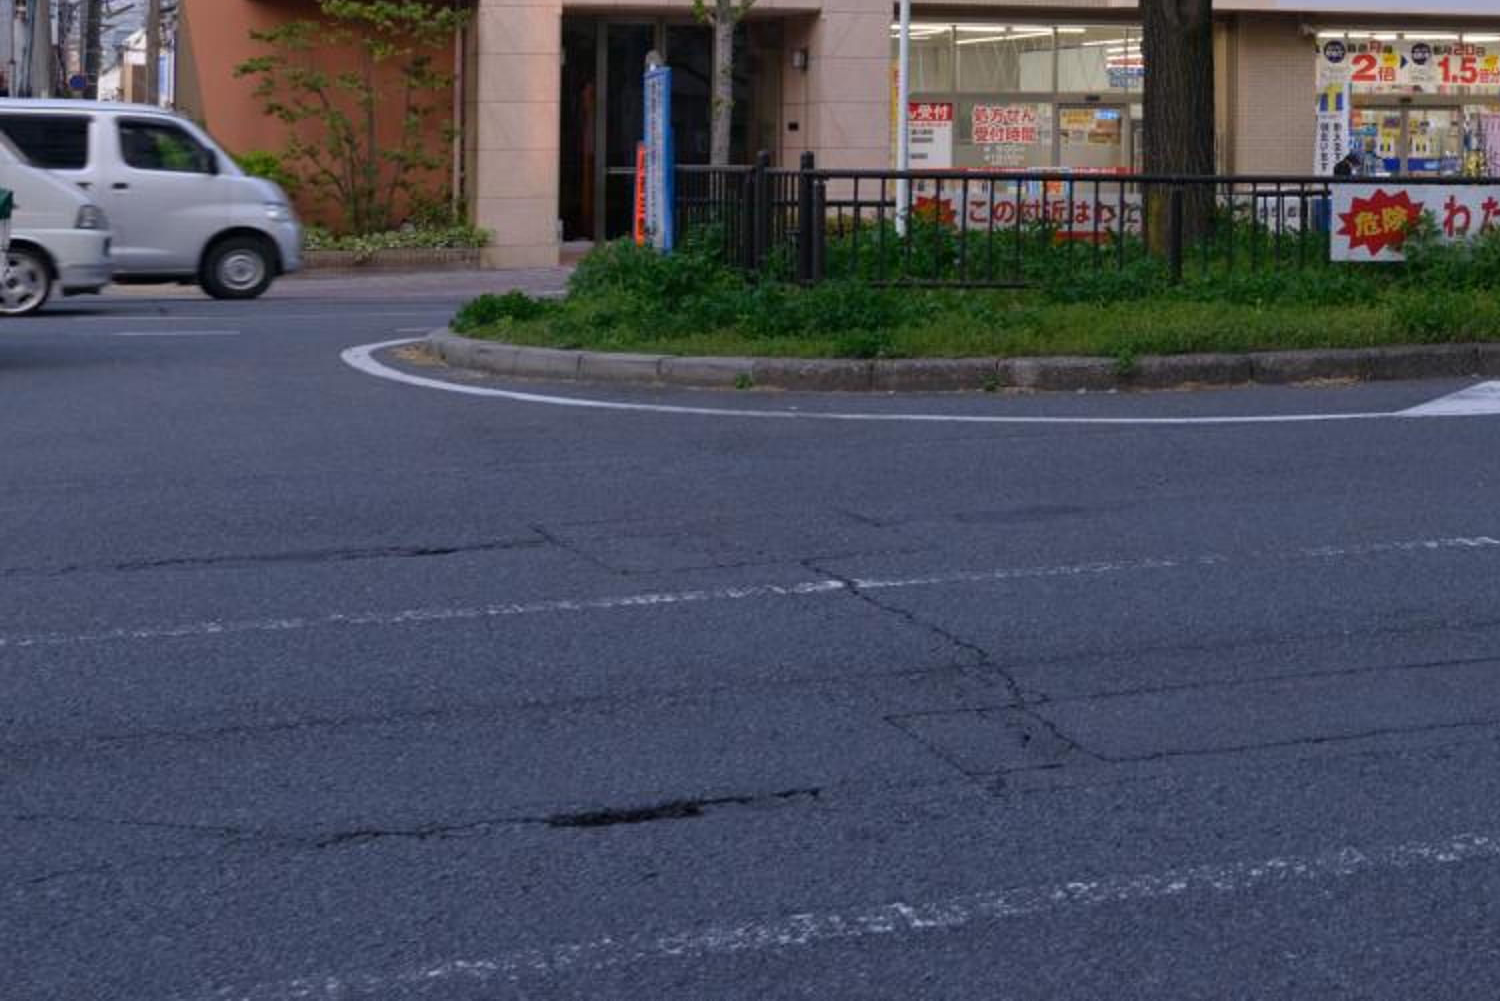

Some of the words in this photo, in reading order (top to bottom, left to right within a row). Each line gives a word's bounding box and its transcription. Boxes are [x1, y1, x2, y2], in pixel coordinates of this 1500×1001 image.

[973, 125, 1037, 143] 受付時間
[1354, 205, 1409, 238] 危険
